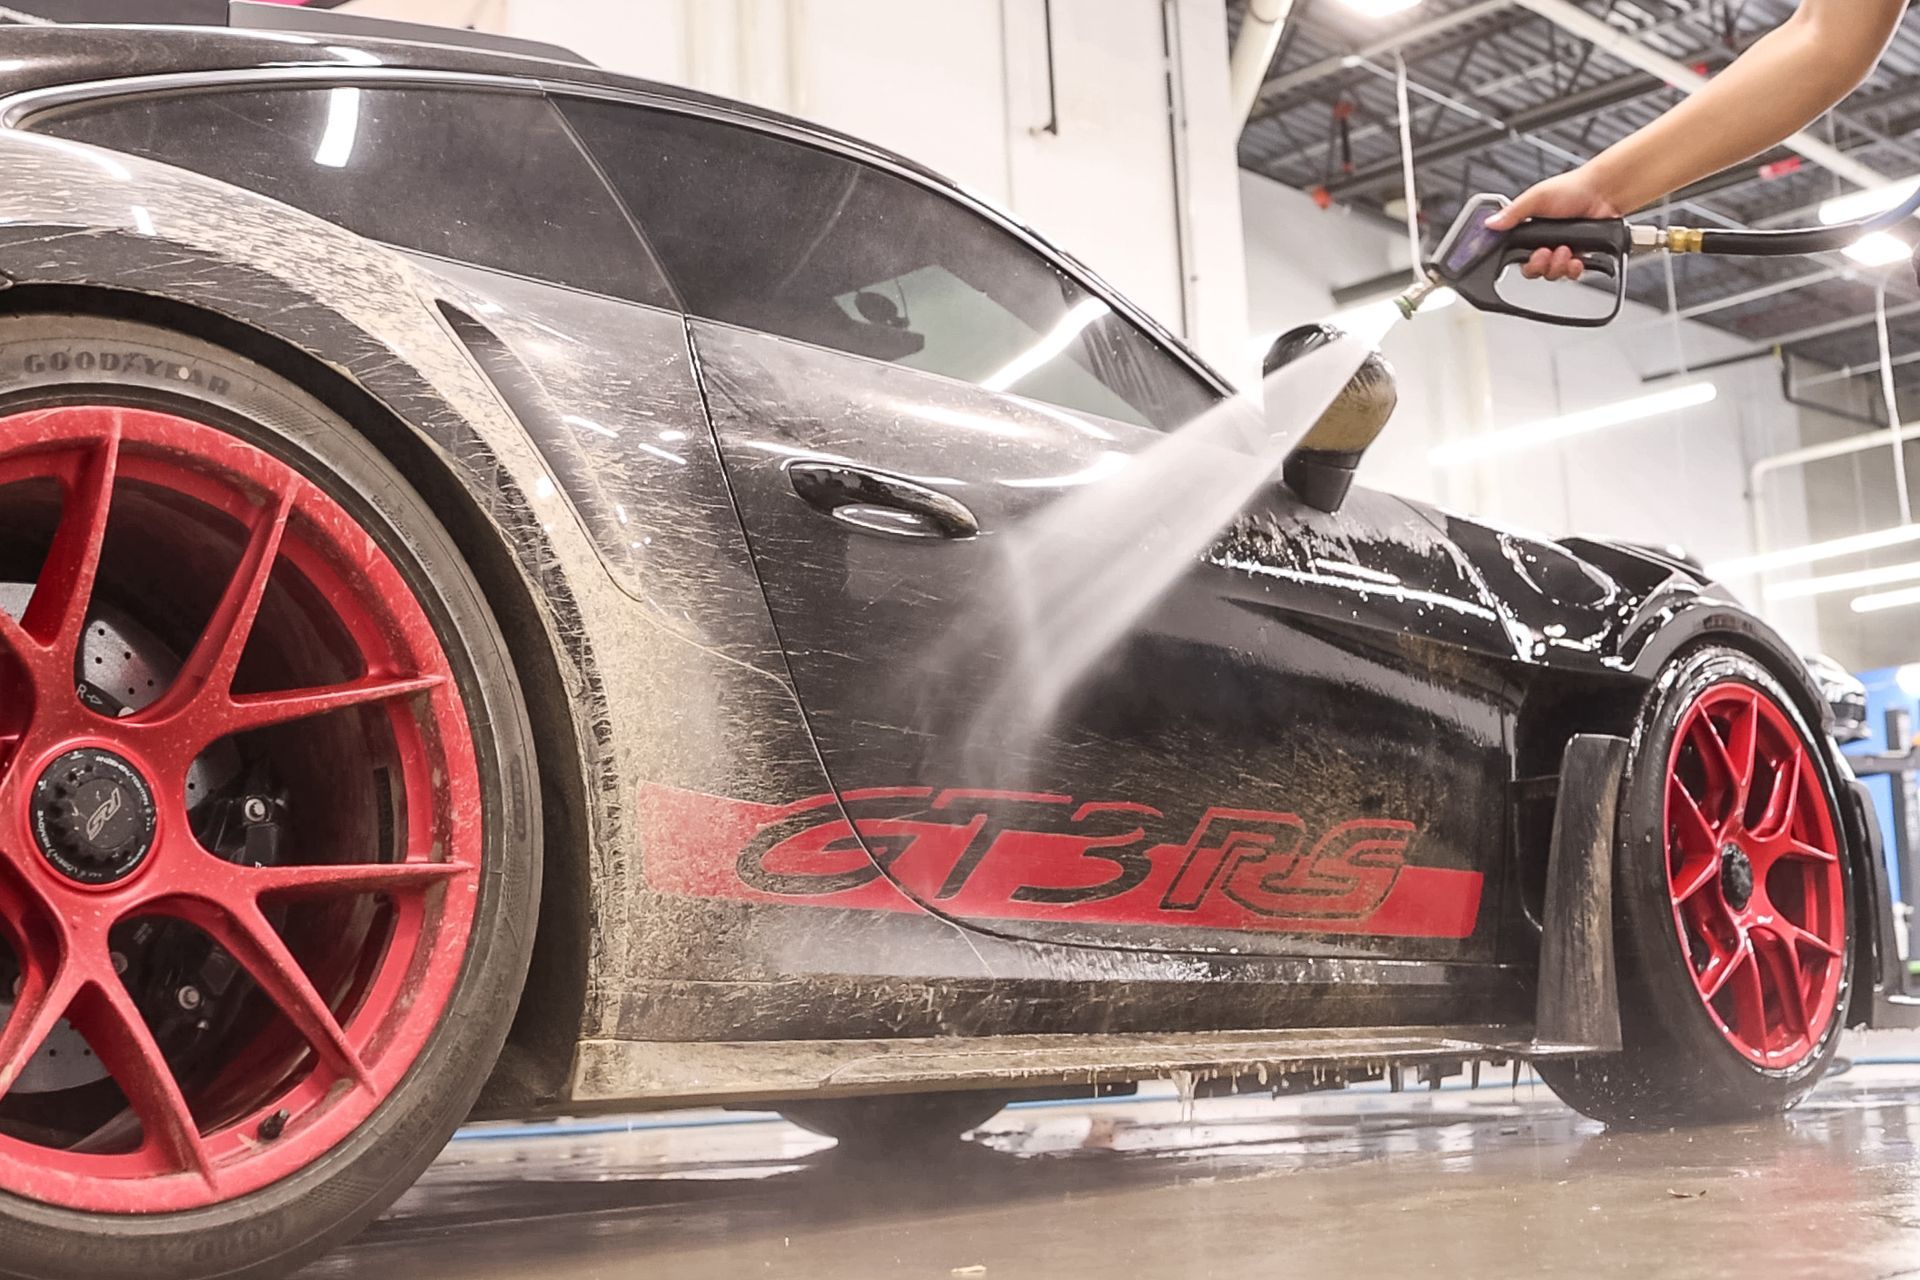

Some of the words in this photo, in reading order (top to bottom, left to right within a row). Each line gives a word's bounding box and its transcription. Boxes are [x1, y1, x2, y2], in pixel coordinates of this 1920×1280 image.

[23, 350, 231, 396] GOODYEAR
[735, 785, 1166, 906] GT3
[1158, 806, 1416, 921] RS
